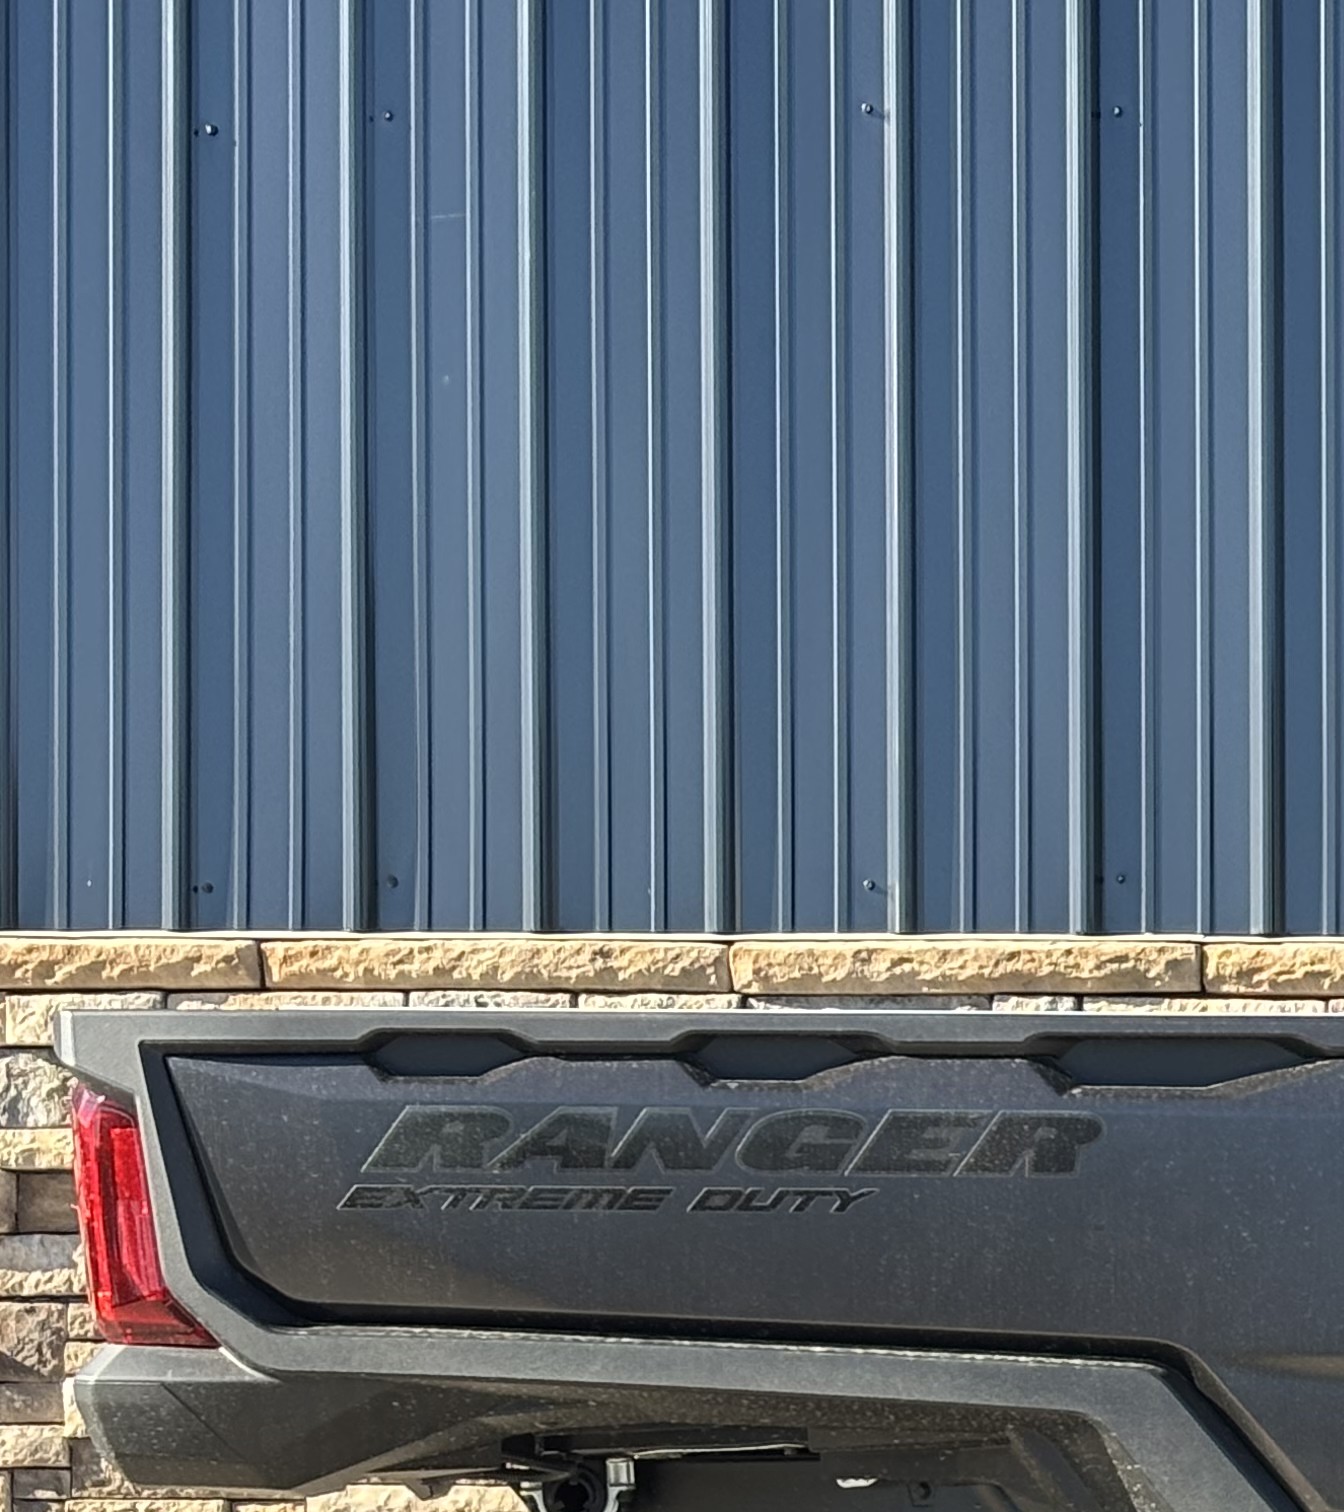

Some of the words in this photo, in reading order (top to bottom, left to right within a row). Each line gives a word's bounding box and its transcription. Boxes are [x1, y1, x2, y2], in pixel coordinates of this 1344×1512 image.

[361, 1105, 1106, 1178] RANGER
[336, 1184, 674, 1213] EXTREME
[687, 1186, 880, 1214] DUTY
